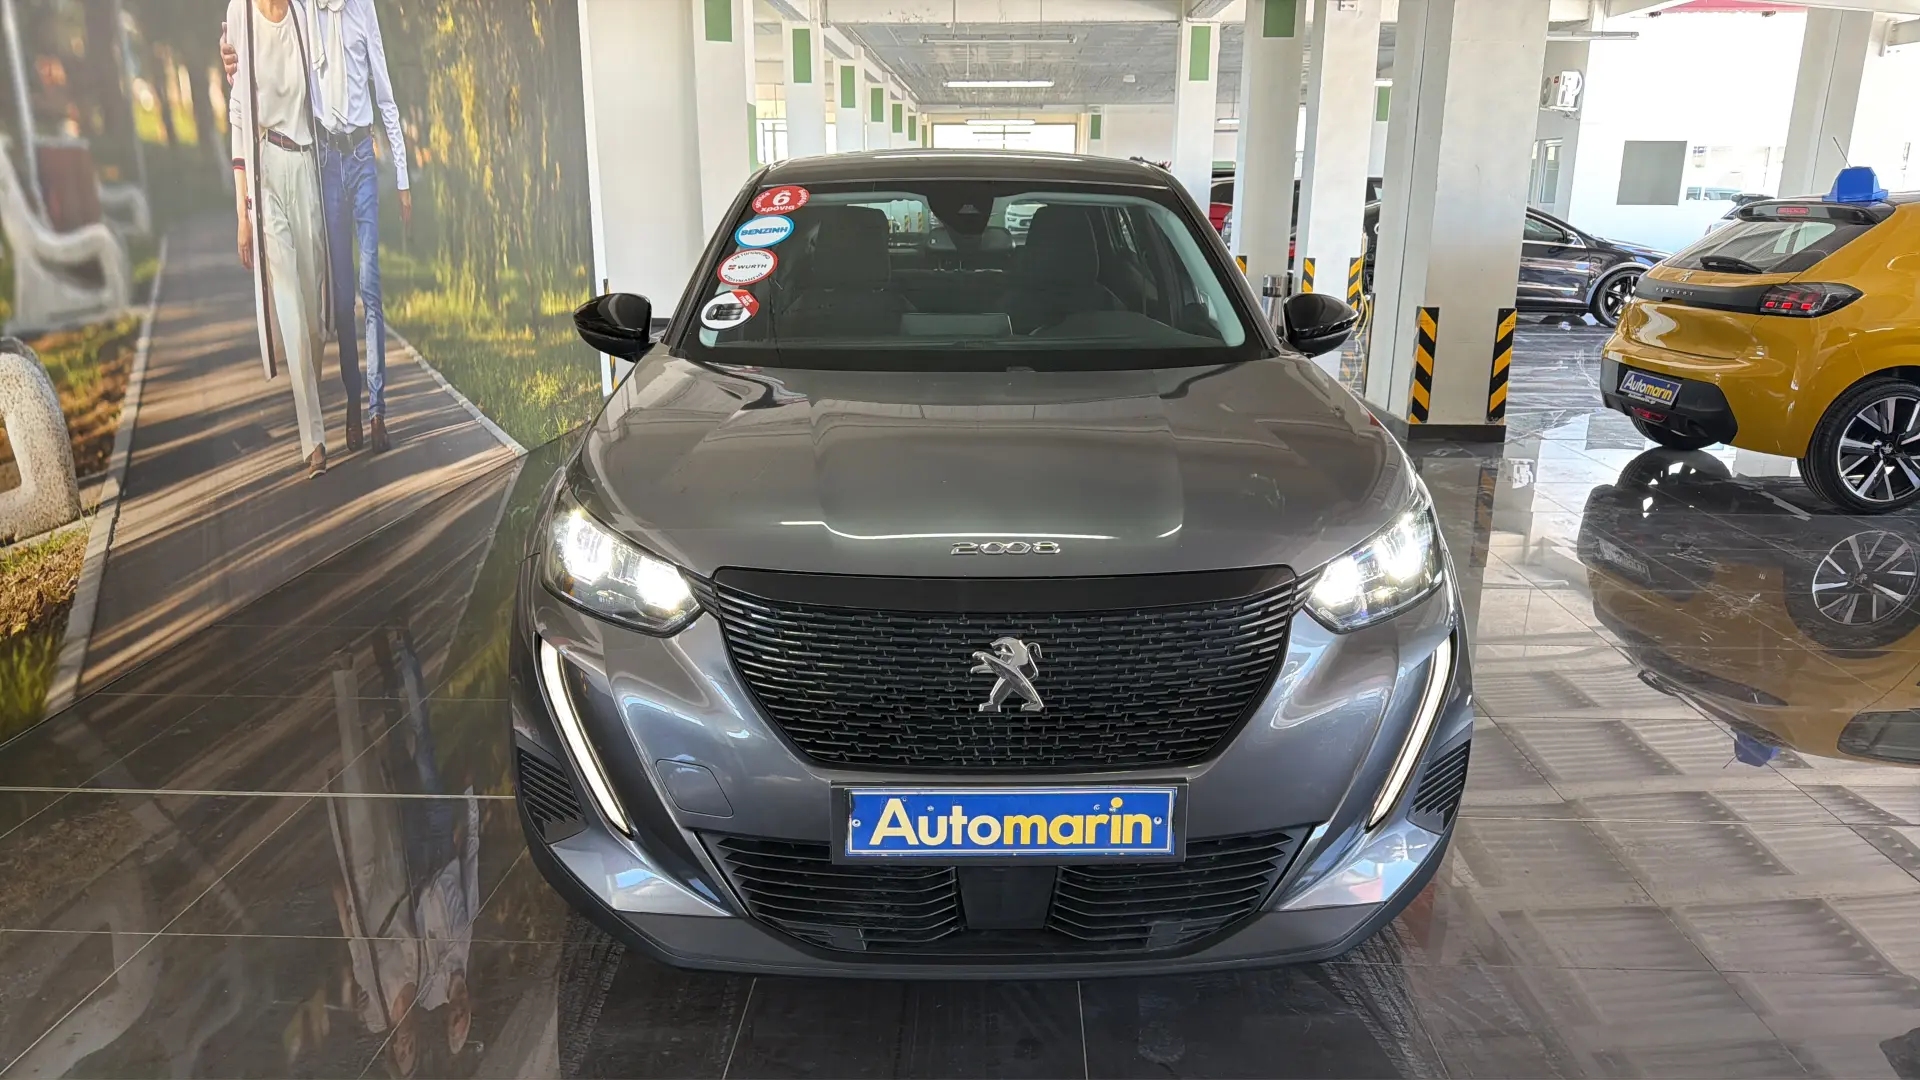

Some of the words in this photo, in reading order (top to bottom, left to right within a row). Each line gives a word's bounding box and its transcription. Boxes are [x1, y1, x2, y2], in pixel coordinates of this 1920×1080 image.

[772, 192, 792, 206] 6
[760, 205, 795, 213] χρόνια
[1623, 374, 1673, 400] Automarin
[951, 541, 1061, 556] 2008
[868, 796, 1153, 846] Automarin
